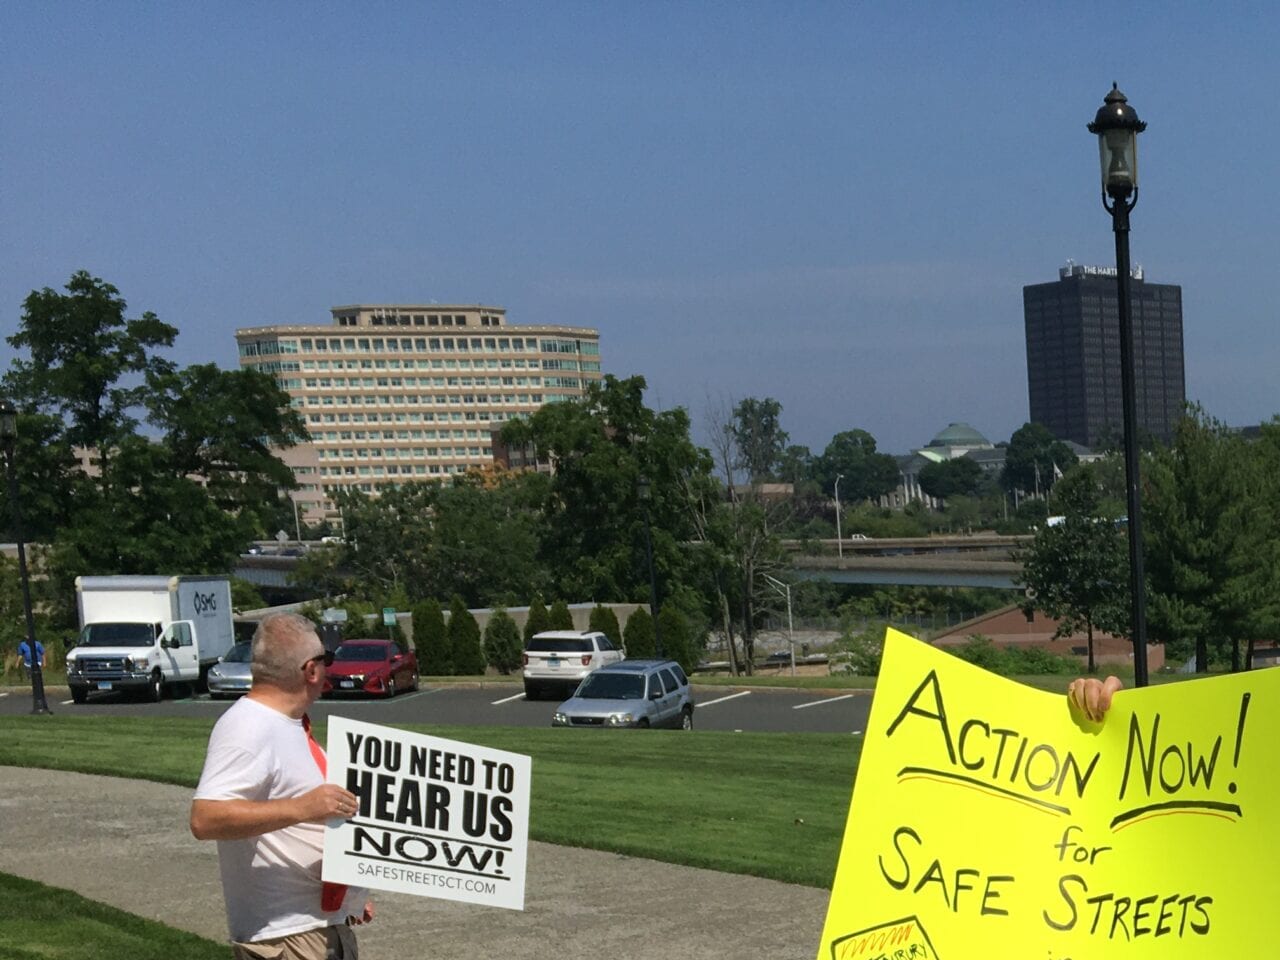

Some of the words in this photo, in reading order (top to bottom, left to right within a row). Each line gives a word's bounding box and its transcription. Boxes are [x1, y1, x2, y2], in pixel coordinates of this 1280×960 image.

[1084, 265, 1097, 275] THE
[886, 669, 1100, 798] ACTION
[1119, 692, 1251, 801] NOW!
[346, 732, 402, 772] YOU
[409, 745, 475, 786] NEED
[482, 759, 515, 794] TO
[346, 767, 451, 832] HEAR
[462, 790, 513, 843] US
[353, 827, 505, 875] NOW!
[1054, 826, 1113, 866] for
[357, 862, 497, 895] SAFESTREETSCT.COM
[878, 826, 1015, 917] SAFE
[1042, 874, 1213, 941] STREETS
